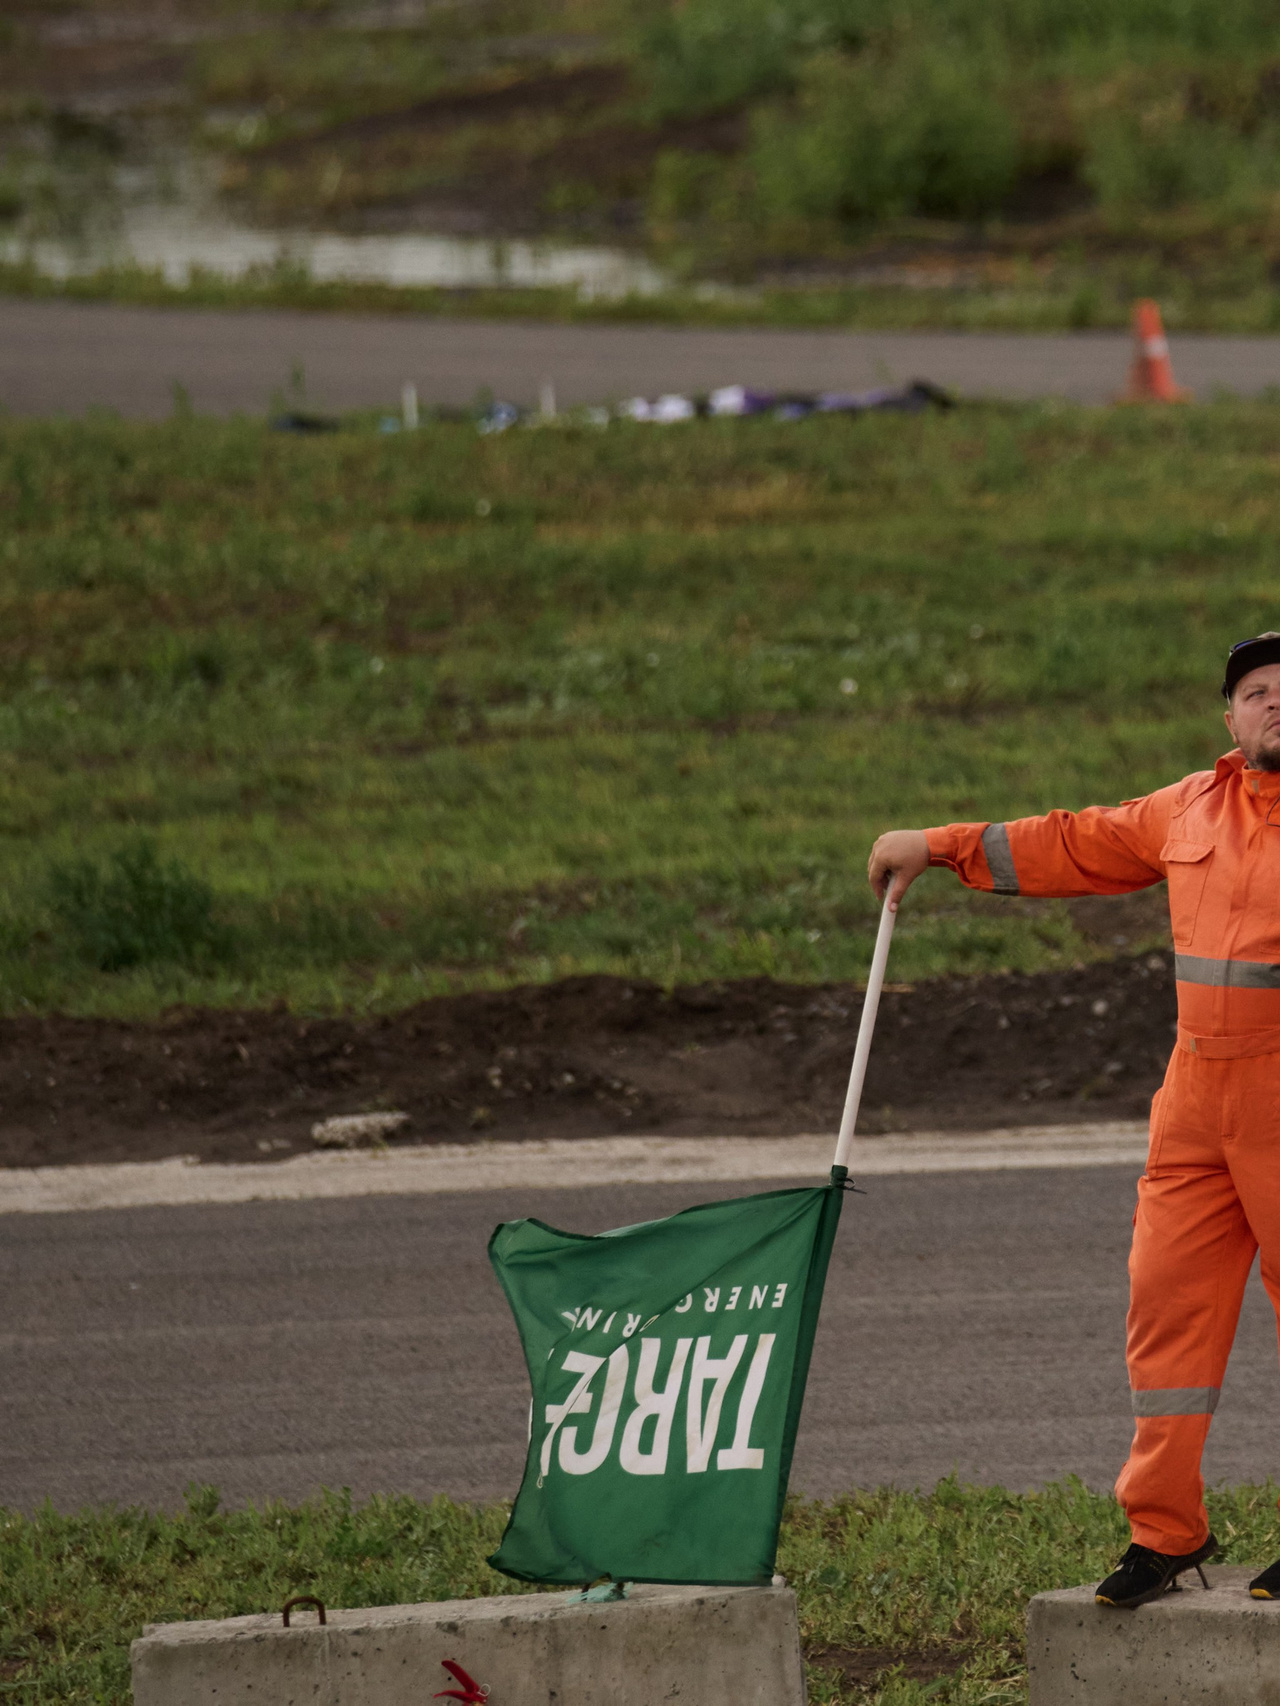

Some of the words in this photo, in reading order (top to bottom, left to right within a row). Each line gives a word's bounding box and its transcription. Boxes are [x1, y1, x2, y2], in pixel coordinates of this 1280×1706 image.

[674, 1282, 788, 1314] ENERG
[561, 1309, 660, 1338] RINK
[541, 1332, 777, 1477] TARGE
